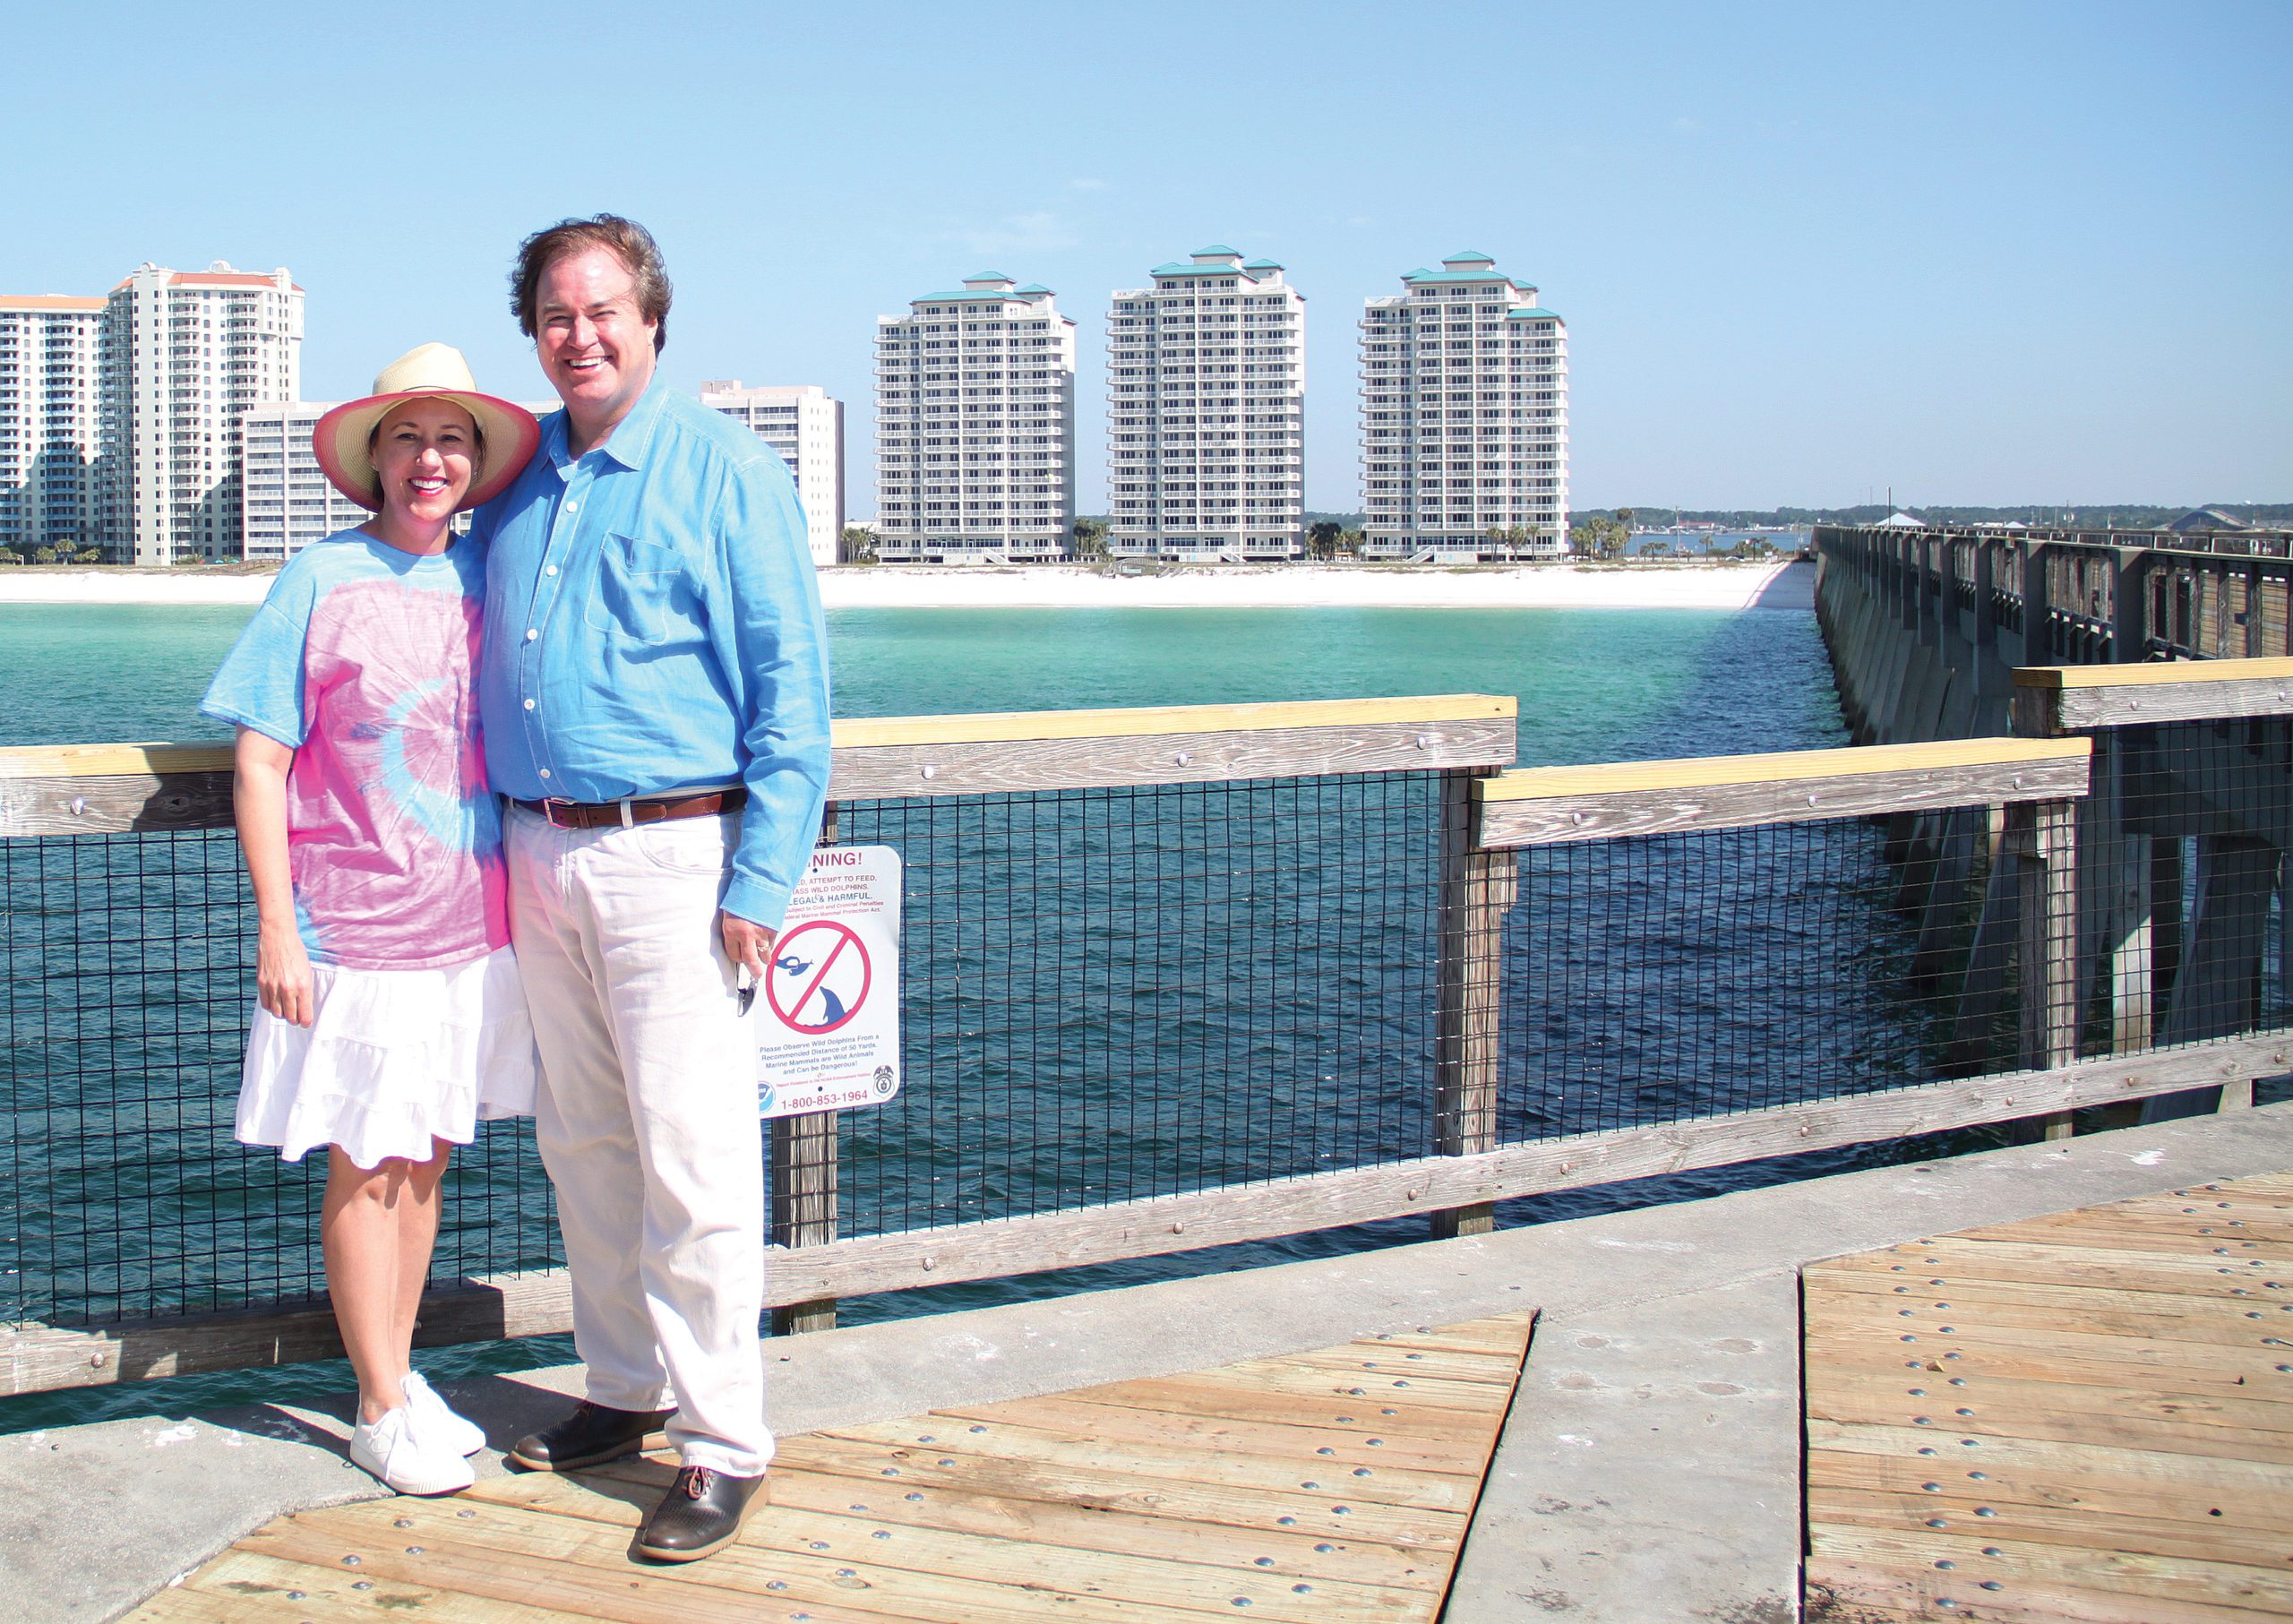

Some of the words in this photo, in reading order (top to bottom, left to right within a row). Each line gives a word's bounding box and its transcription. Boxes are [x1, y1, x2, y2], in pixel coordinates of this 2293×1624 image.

[808, 852, 862, 867] NING!
[810, 876, 842, 884] ATTEMPT
[811, 886, 829, 894] WILD
[831, 883, 869, 892] DOLPHINS.
[828, 892, 873, 903] HARMFUL.
[760, 1045, 781, 1053] Please
[783, 1043, 810, 1051] Observe
[812, 1039, 826, 1047] Wild
[828, 1037, 855, 1046] Dolphins
[761, 1050, 810, 1061] Recommended
[812, 1046, 839, 1055] Distance
[765, 1061, 788, 1069] Marine
[788, 1057, 820, 1066] Mammals
[848, 1050, 874, 1059] Animals
[812, 1063, 819, 1071] be
[820, 1061, 858, 1071] Dangerous!
[781, 1089, 868, 1110] 1-800-853-1964
